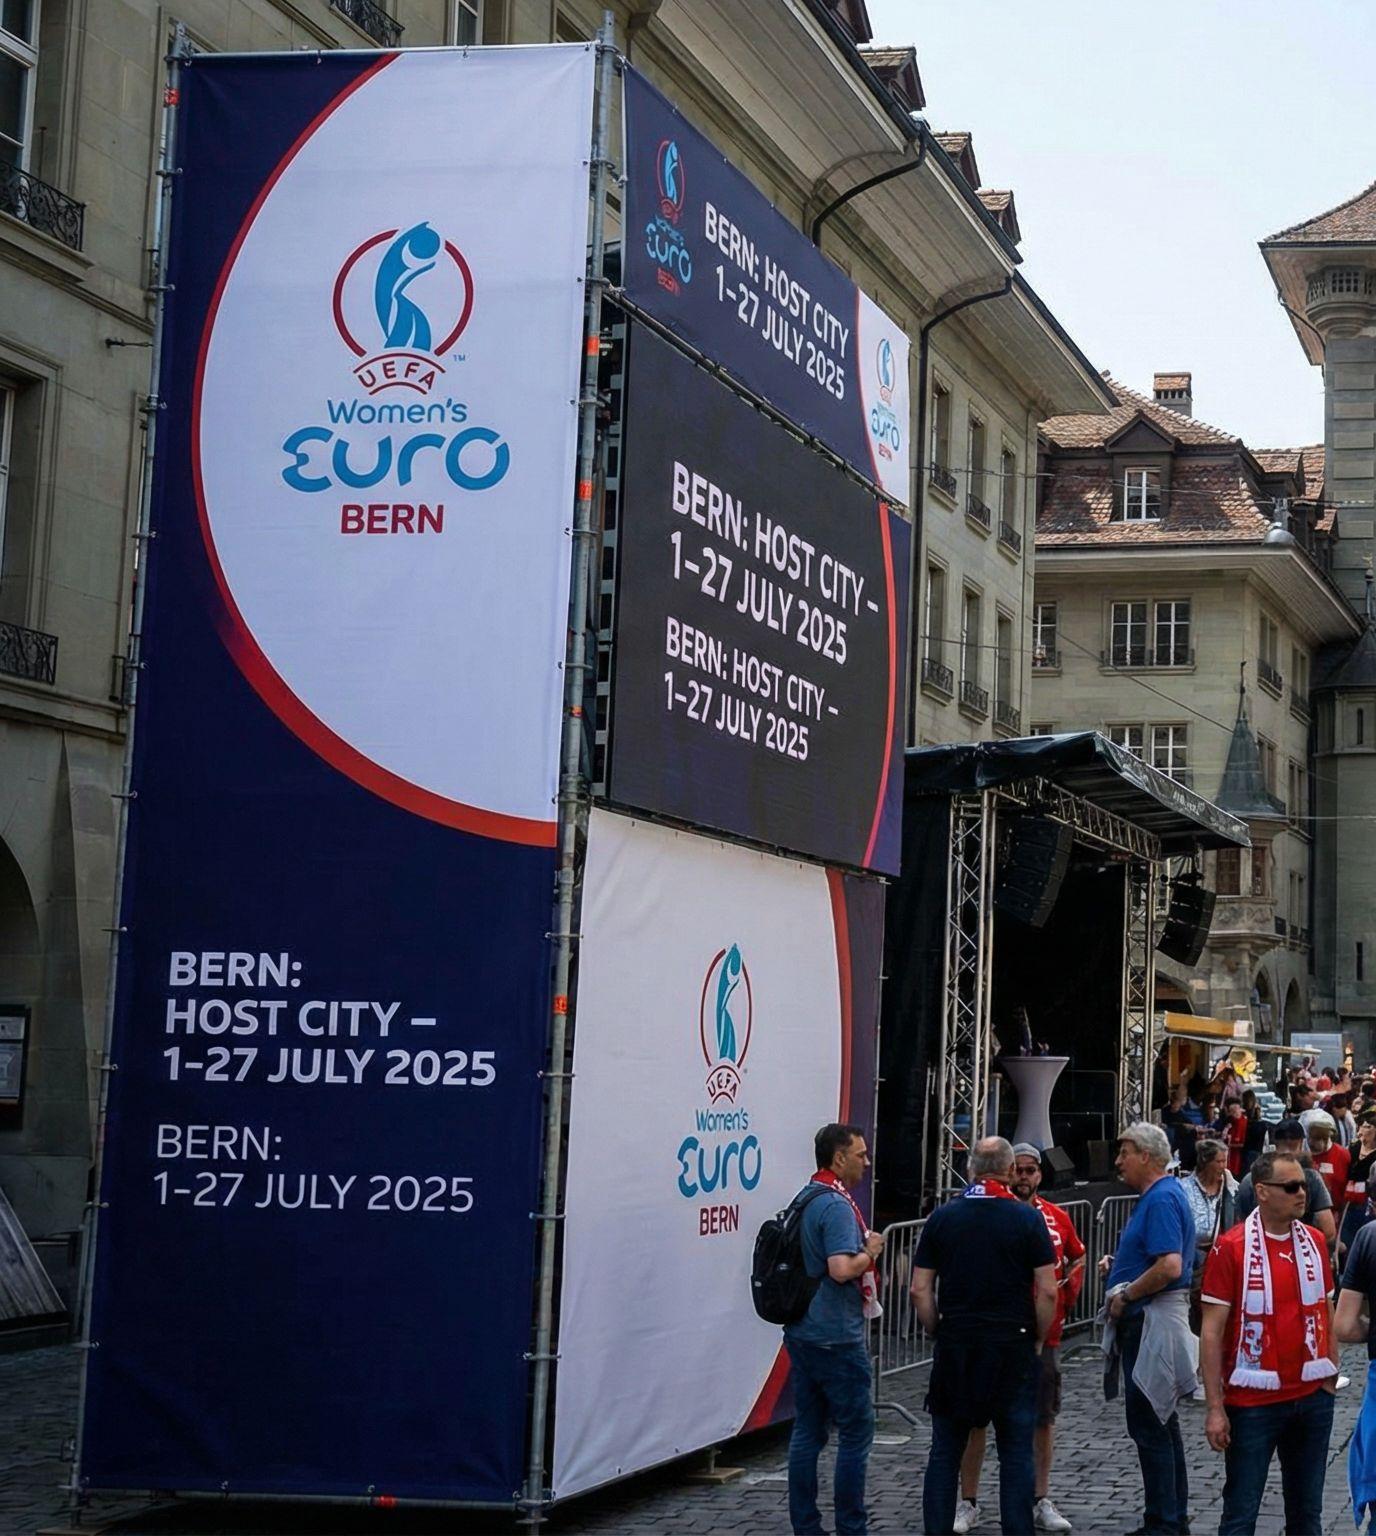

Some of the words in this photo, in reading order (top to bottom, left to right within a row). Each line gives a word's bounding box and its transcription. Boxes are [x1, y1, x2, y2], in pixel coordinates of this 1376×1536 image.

[705, 202, 760, 283] BERN:
[765, 255, 811, 326] HOST
[813, 299, 850, 359] CITY
[762, 307, 804, 366] JULY
[806, 342, 846, 402] 2025
[357, 361, 437, 391] UEFA
[327, 398, 467, 424] Women's
[340, 504, 444, 534] BERN
[672, 460, 749, 553] BERN:
[755, 511, 815, 588] HOST
[819, 553, 865, 618] CITY
[737, 568, 794, 636] JULY
[796, 599, 847, 665] 2025
[665, 616, 728, 680] BERN:
[732, 647, 783, 702] HOST
[787, 675, 826, 721] CITY
[715, 695, 762, 746] JULY
[765, 715, 809, 762] 2025
[169, 951, 302, 987] BERN:
[165, 999, 288, 1035] HOST
[298, 1001, 401, 1037] CITY
[267, 1049, 374, 1084] JULY
[384, 1050, 497, 1086] 2025
[706, 1073, 738, 1099] UEFA
[695, 1107, 749, 1132] Women's
[157, 1124, 282, 1160] BERN:
[255, 1174, 357, 1210] JULY
[367, 1175, 474, 1213] 2025
[699, 1204, 739, 1236] BERN
